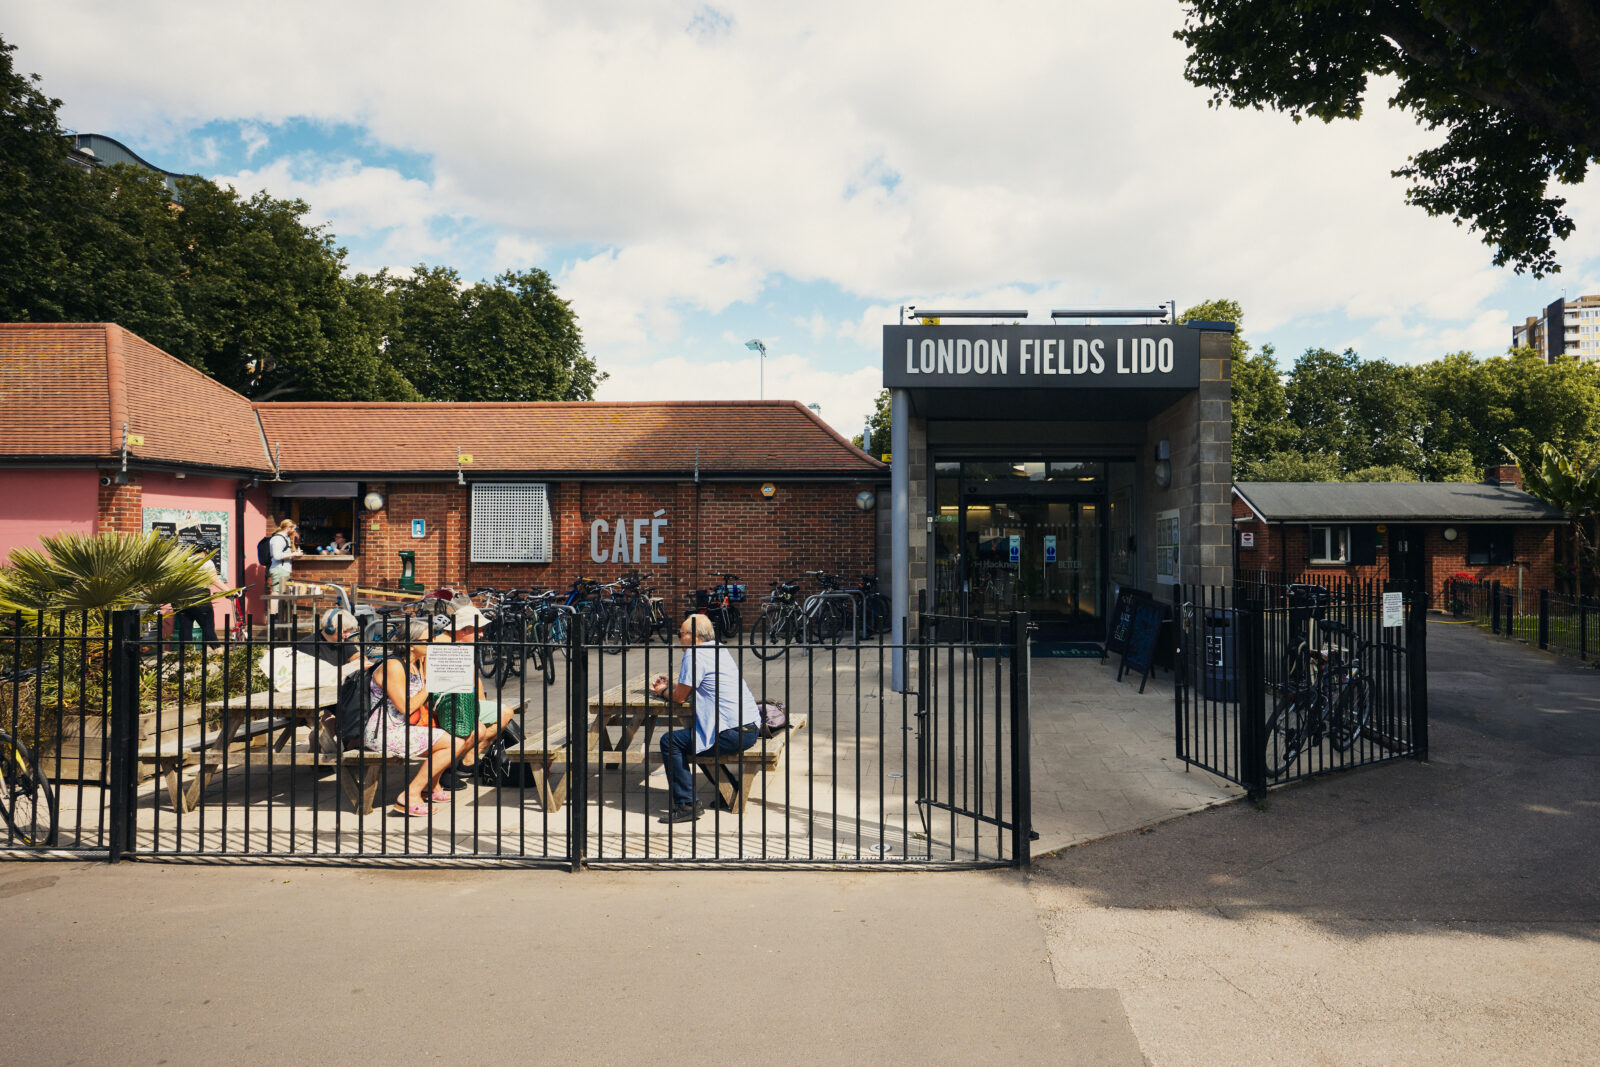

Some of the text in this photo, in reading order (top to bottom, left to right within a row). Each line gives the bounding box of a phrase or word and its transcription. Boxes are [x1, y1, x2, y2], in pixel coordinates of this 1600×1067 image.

[906, 337, 1174, 375] LONDON FIELDS LIDO
[590, 508, 668, 564] CAFÉ
[983, 560, 1019, 569] Hackney
